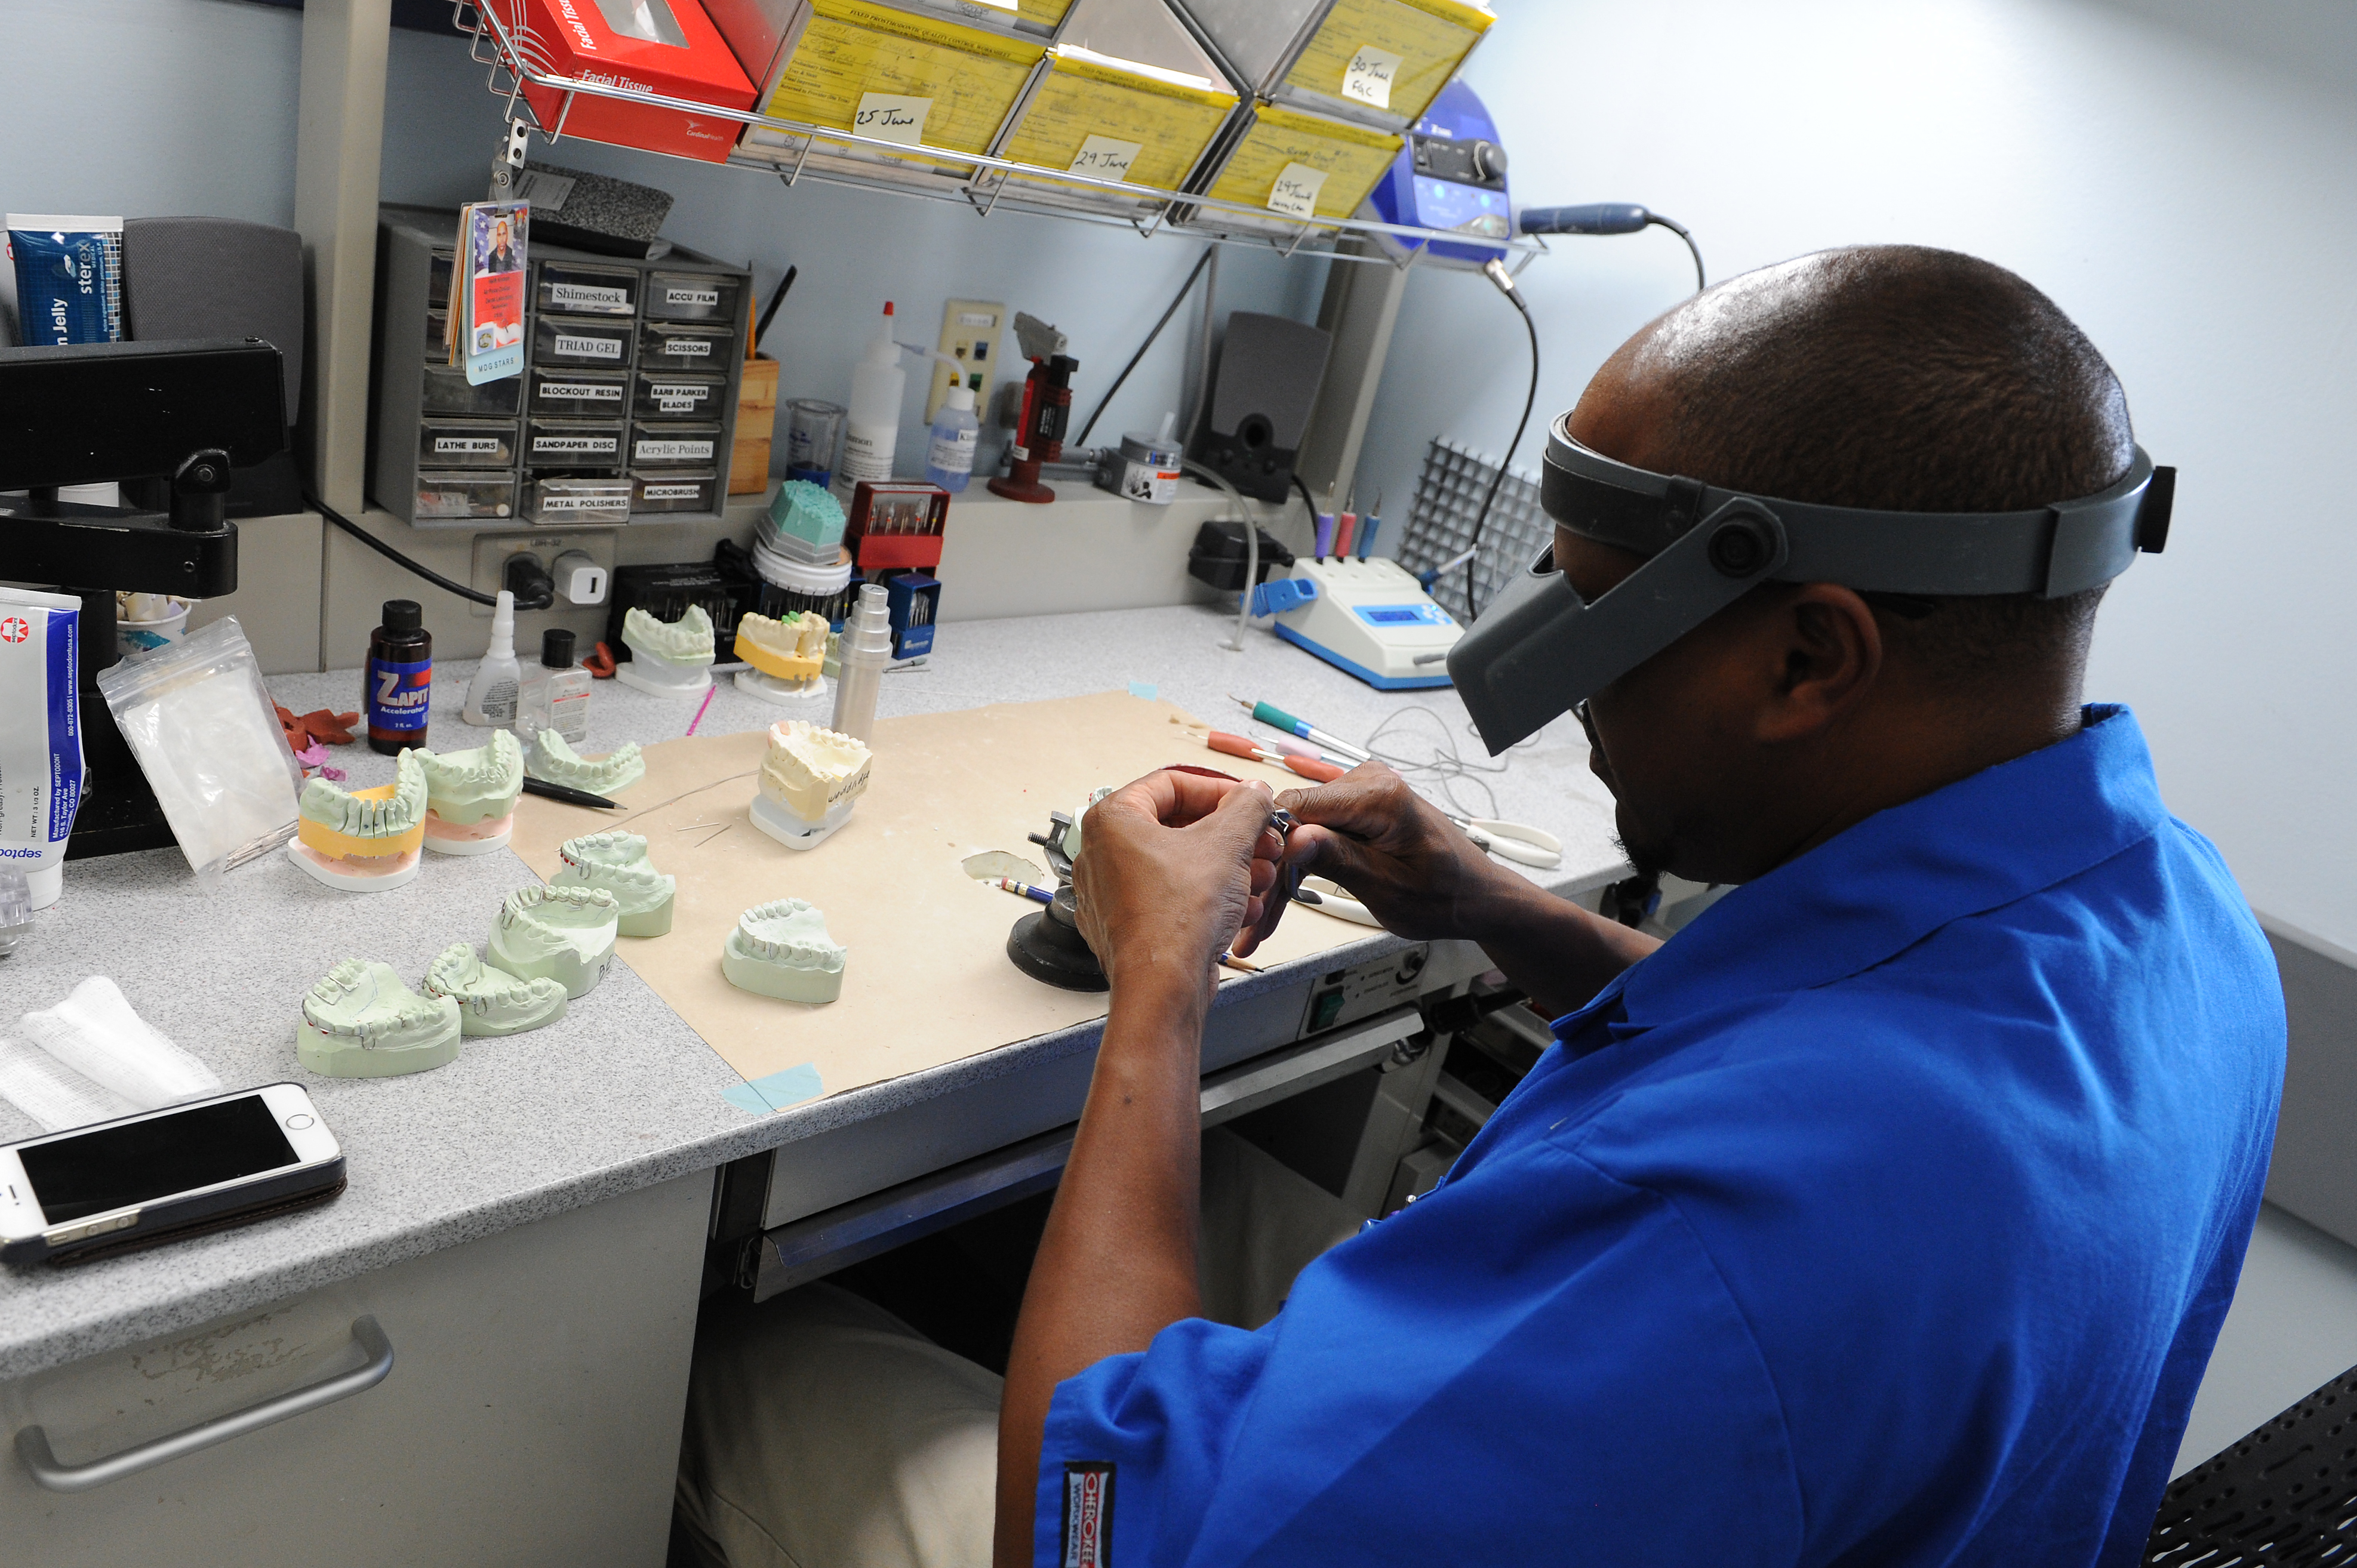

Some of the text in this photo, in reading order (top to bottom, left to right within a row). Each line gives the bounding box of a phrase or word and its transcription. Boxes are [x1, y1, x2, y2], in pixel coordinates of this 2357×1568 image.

[850, 10, 870, 19] FIXED
[869, 14, 919, 33] PROSTHODONTIC
[567, 20, 596, 50] Facial
[1351, 56, 1367, 72] 30
[583, 69, 653, 93] Facial Tissue
[857, 108, 914, 125] 25 June
[1075, 151, 1128, 169] 29 June
[78, 242, 93, 294] sterex
[556, 288, 620, 303] Shimestock
[669, 292, 693, 301] ACCU
[51, 298, 68, 333] Jelly
[558, 340, 619, 353] TRIAD GEL
[667, 344, 709, 352] SCISSORS
[479, 357, 514, 371] MDG STARS
[542, 387, 620, 397] BLOCKOUT RESIN
[676, 388, 706, 396] PARKER
[437, 441, 467, 449] LATHE
[536, 440, 588, 449] SANDPAPER
[639, 445, 710, 455] Acrylic Points
[645, 488, 699, 497] MICROBRUSH
[545, 498, 627, 508] METAL POLISHERS
[377, 669, 429, 706] ZAPIT
[380, 706, 425, 714] Accelerator
[53, 753, 62, 839] Manufactured by SEPTODONT
[69, 799, 75, 808] CO
[32, 815, 38, 825] WT
[1070, 1483, 1081, 1560] WORKWEAR
[1081, 1472, 1098, 1563] CHEROKEE
